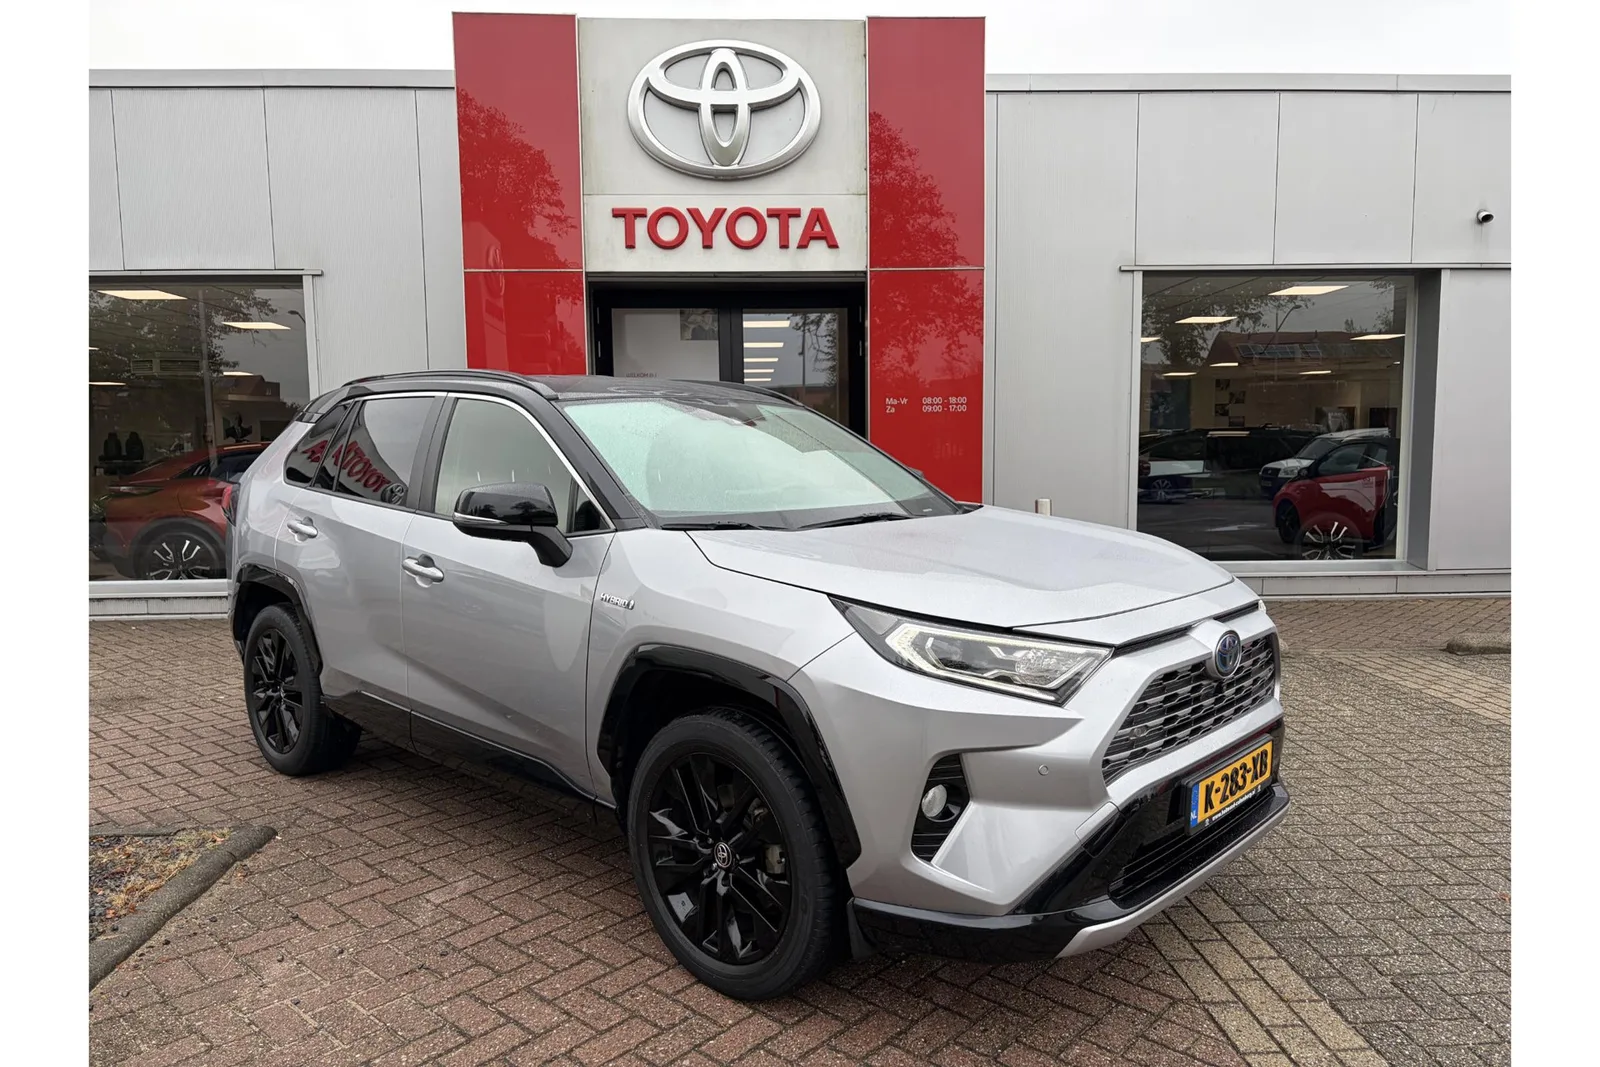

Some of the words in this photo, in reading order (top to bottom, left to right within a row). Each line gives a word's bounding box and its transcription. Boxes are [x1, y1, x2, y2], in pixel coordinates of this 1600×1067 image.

[611, 206, 839, 250] TOYOTA
[885, 397, 908, 405] Ma-Vr
[922, 396, 943, 404] 08:00
[948, 396, 967, 404] 18:00
[600, 592, 628, 608] HYBRID
[1203, 748, 1269, 814] K-283-XB
[1190, 810, 1198, 820] NL
